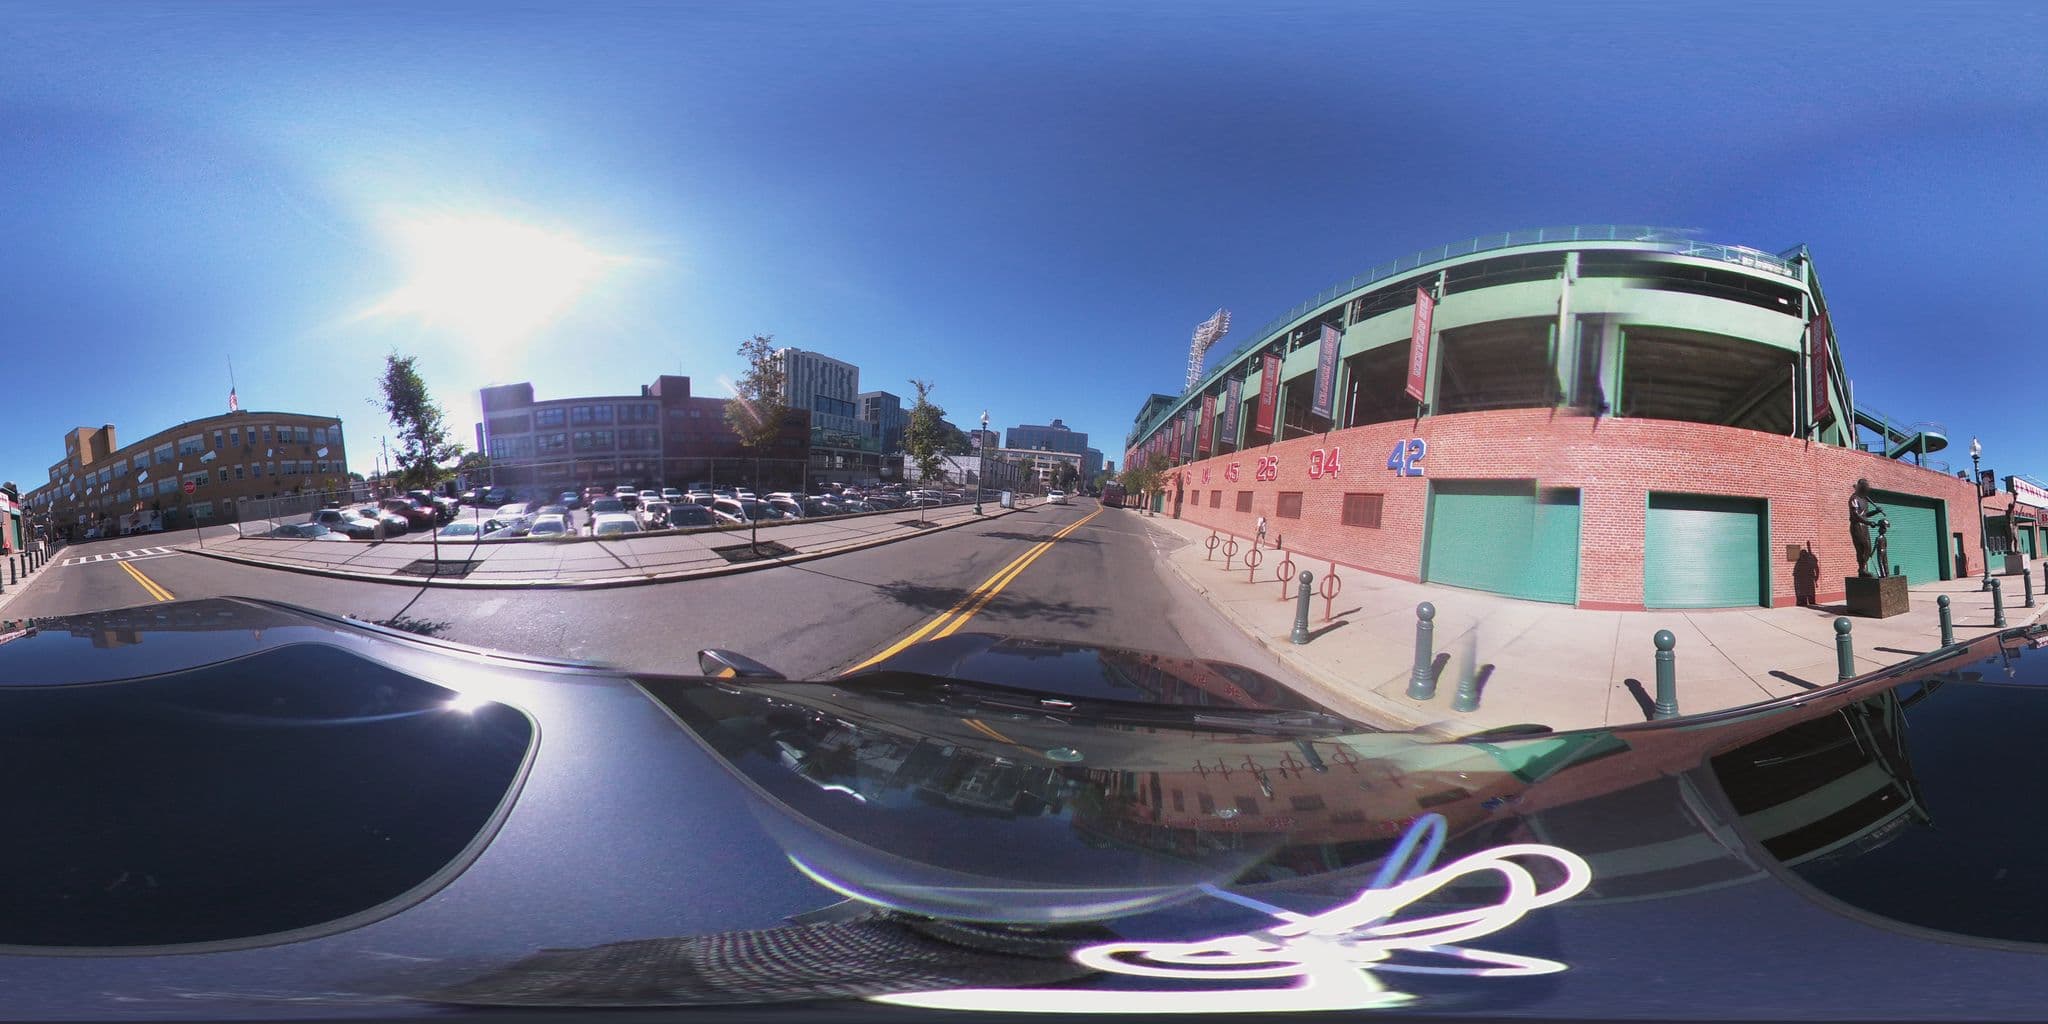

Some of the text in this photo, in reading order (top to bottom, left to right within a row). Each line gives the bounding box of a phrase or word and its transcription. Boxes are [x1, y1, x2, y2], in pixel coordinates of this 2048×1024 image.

[1256, 456, 1279, 481] 26
[1309, 447, 1340, 479] 34
[1387, 438, 1426, 477] 42
[1225, 462, 1240, 483] 45
